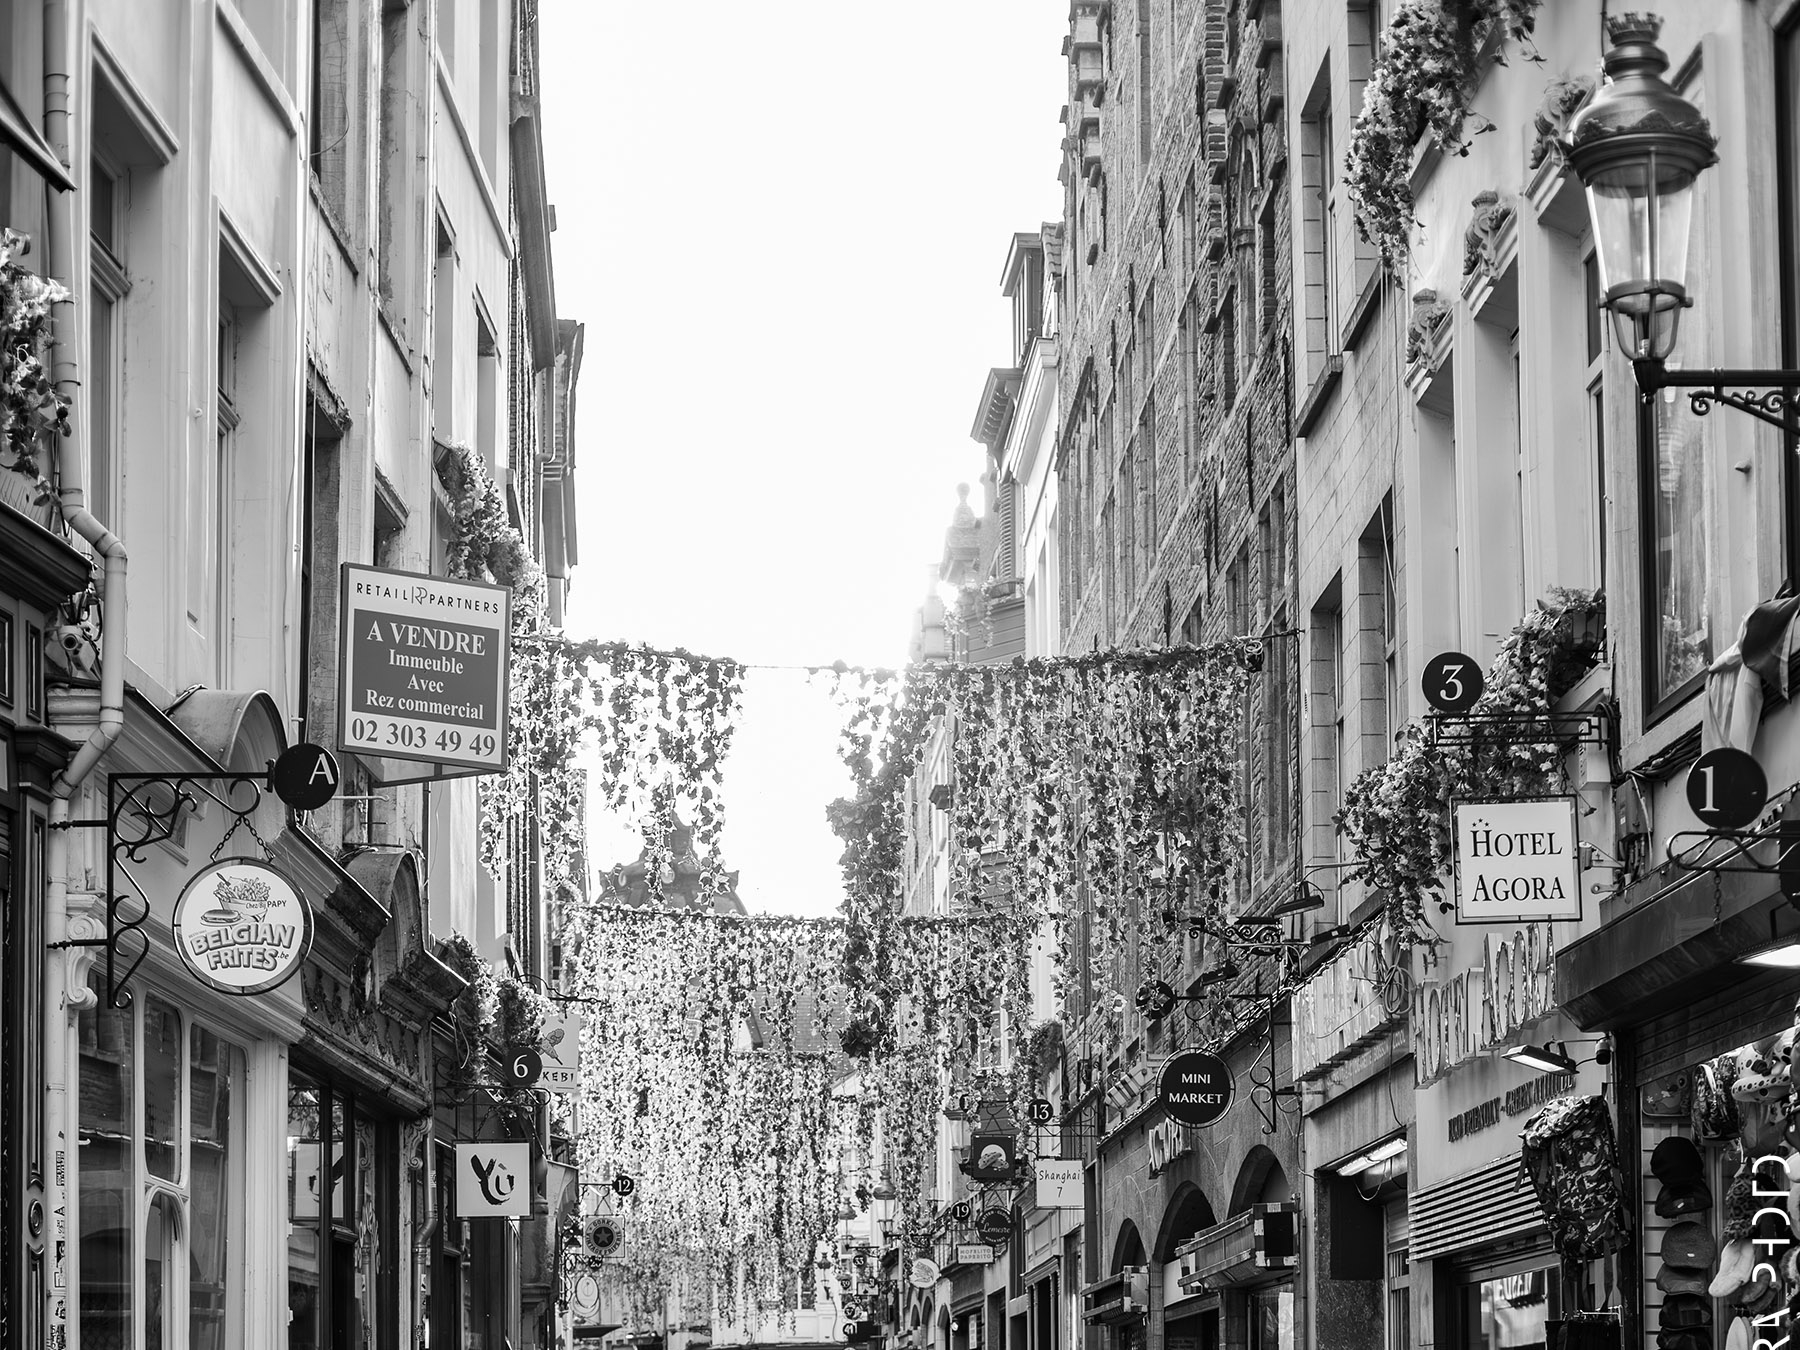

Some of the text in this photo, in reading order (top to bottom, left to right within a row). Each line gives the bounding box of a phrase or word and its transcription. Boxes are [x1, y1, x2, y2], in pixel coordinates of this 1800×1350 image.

[356, 583, 408, 601] RETAIL
[430, 594, 499, 614] PARTNERS
[366, 620, 486, 656] A VENDRE
[388, 649, 464, 675] Immeuble
[407, 674, 444, 693] Avec
[1440, 664, 1464, 701] 3
[366, 689, 484, 720] Rez commercial
[352, 718, 496, 757] 02 303 49 49
[308, 752, 335, 785] A
[1699, 765, 1720, 812] 1
[1470, 829, 1563, 858] HOTEL
[1472, 874, 1566, 902] AGORA
[267, 900, 287, 908] PAPY
[190, 923, 295, 956] BELGIAN
[207, 947, 278, 971] FRITES
[513, 1054, 529, 1078] 6
[1181, 1073, 1211, 1084] MINI
[1168, 1092, 1224, 1105] MARKET
[1031, 1103, 1050, 1121] 13
[617, 1179, 631, 1193] 12
[1039, 1169, 1082, 1184] Shanghai
[1056, 1186, 1063, 1198] 7
[955, 1204, 970, 1218] 19
